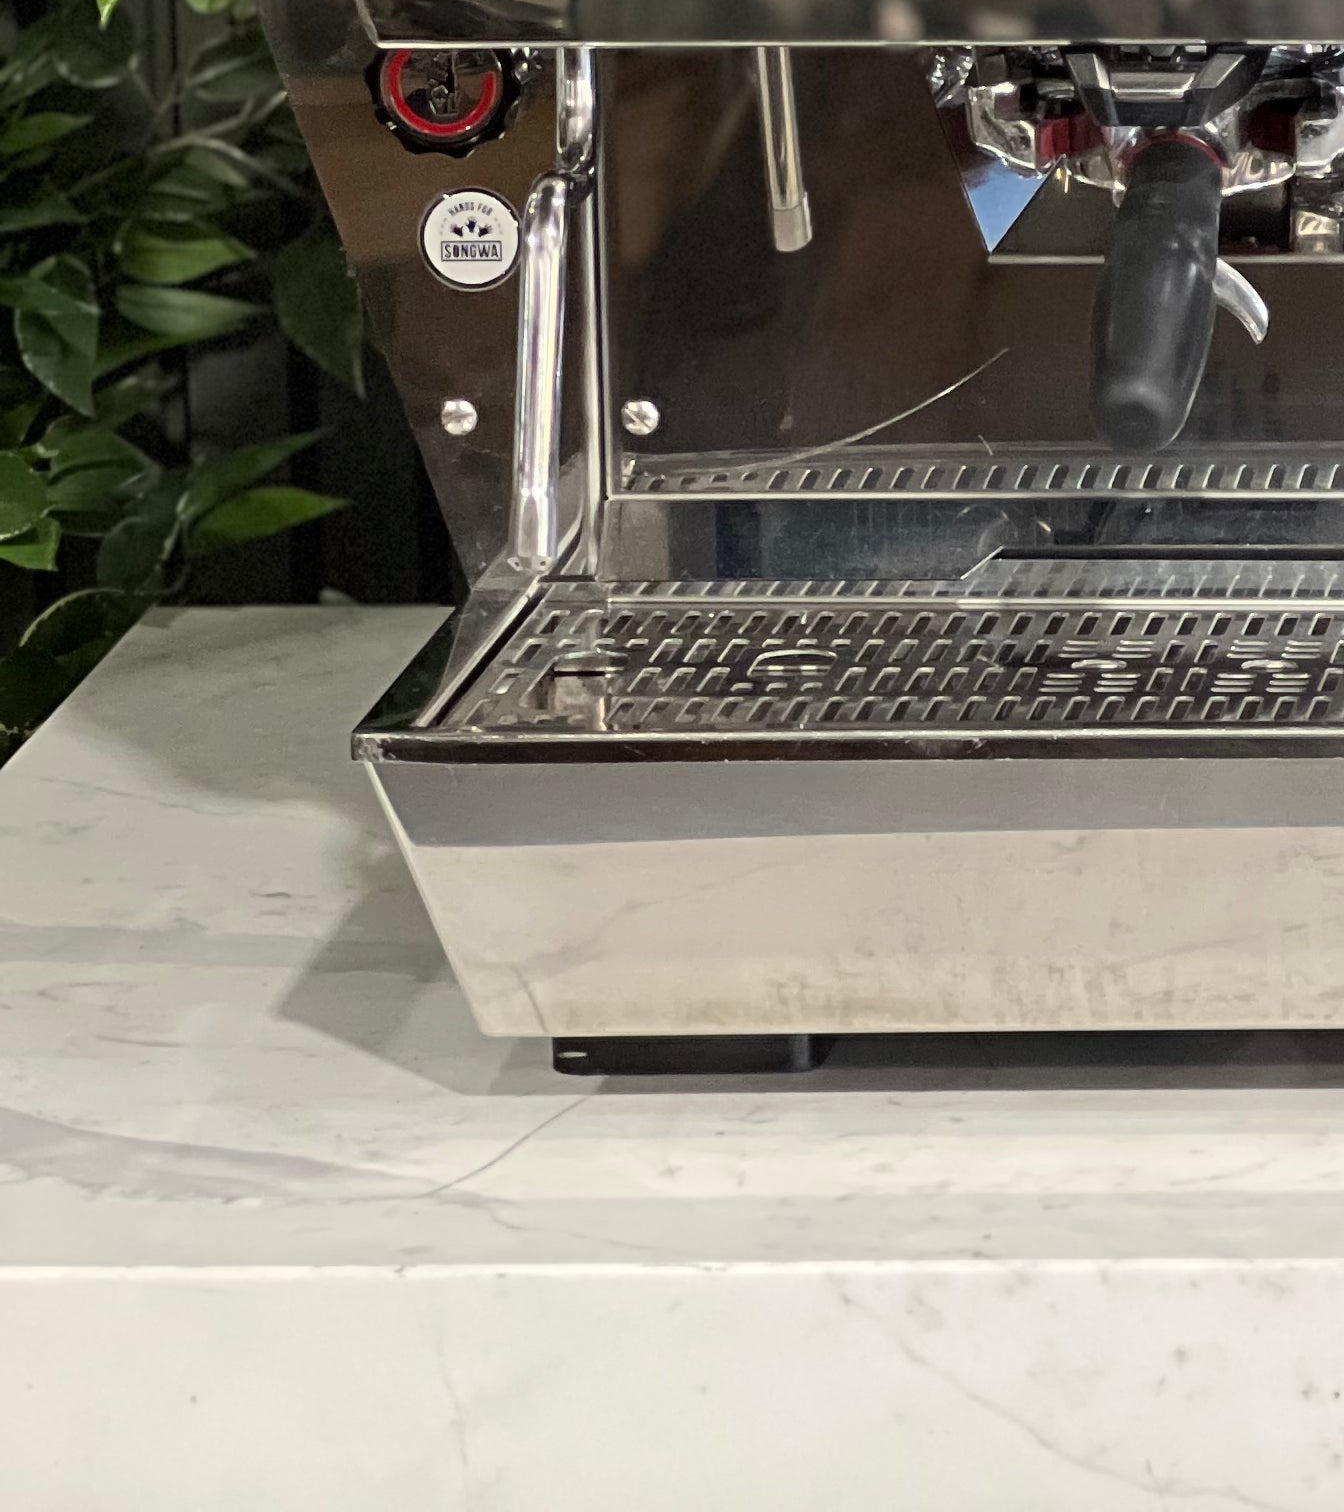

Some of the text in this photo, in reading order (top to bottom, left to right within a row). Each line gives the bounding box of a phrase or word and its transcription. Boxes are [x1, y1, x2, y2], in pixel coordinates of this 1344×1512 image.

[448, 202, 493, 217] HANDS FOR
[444, 244, 499, 259] SONGWA
